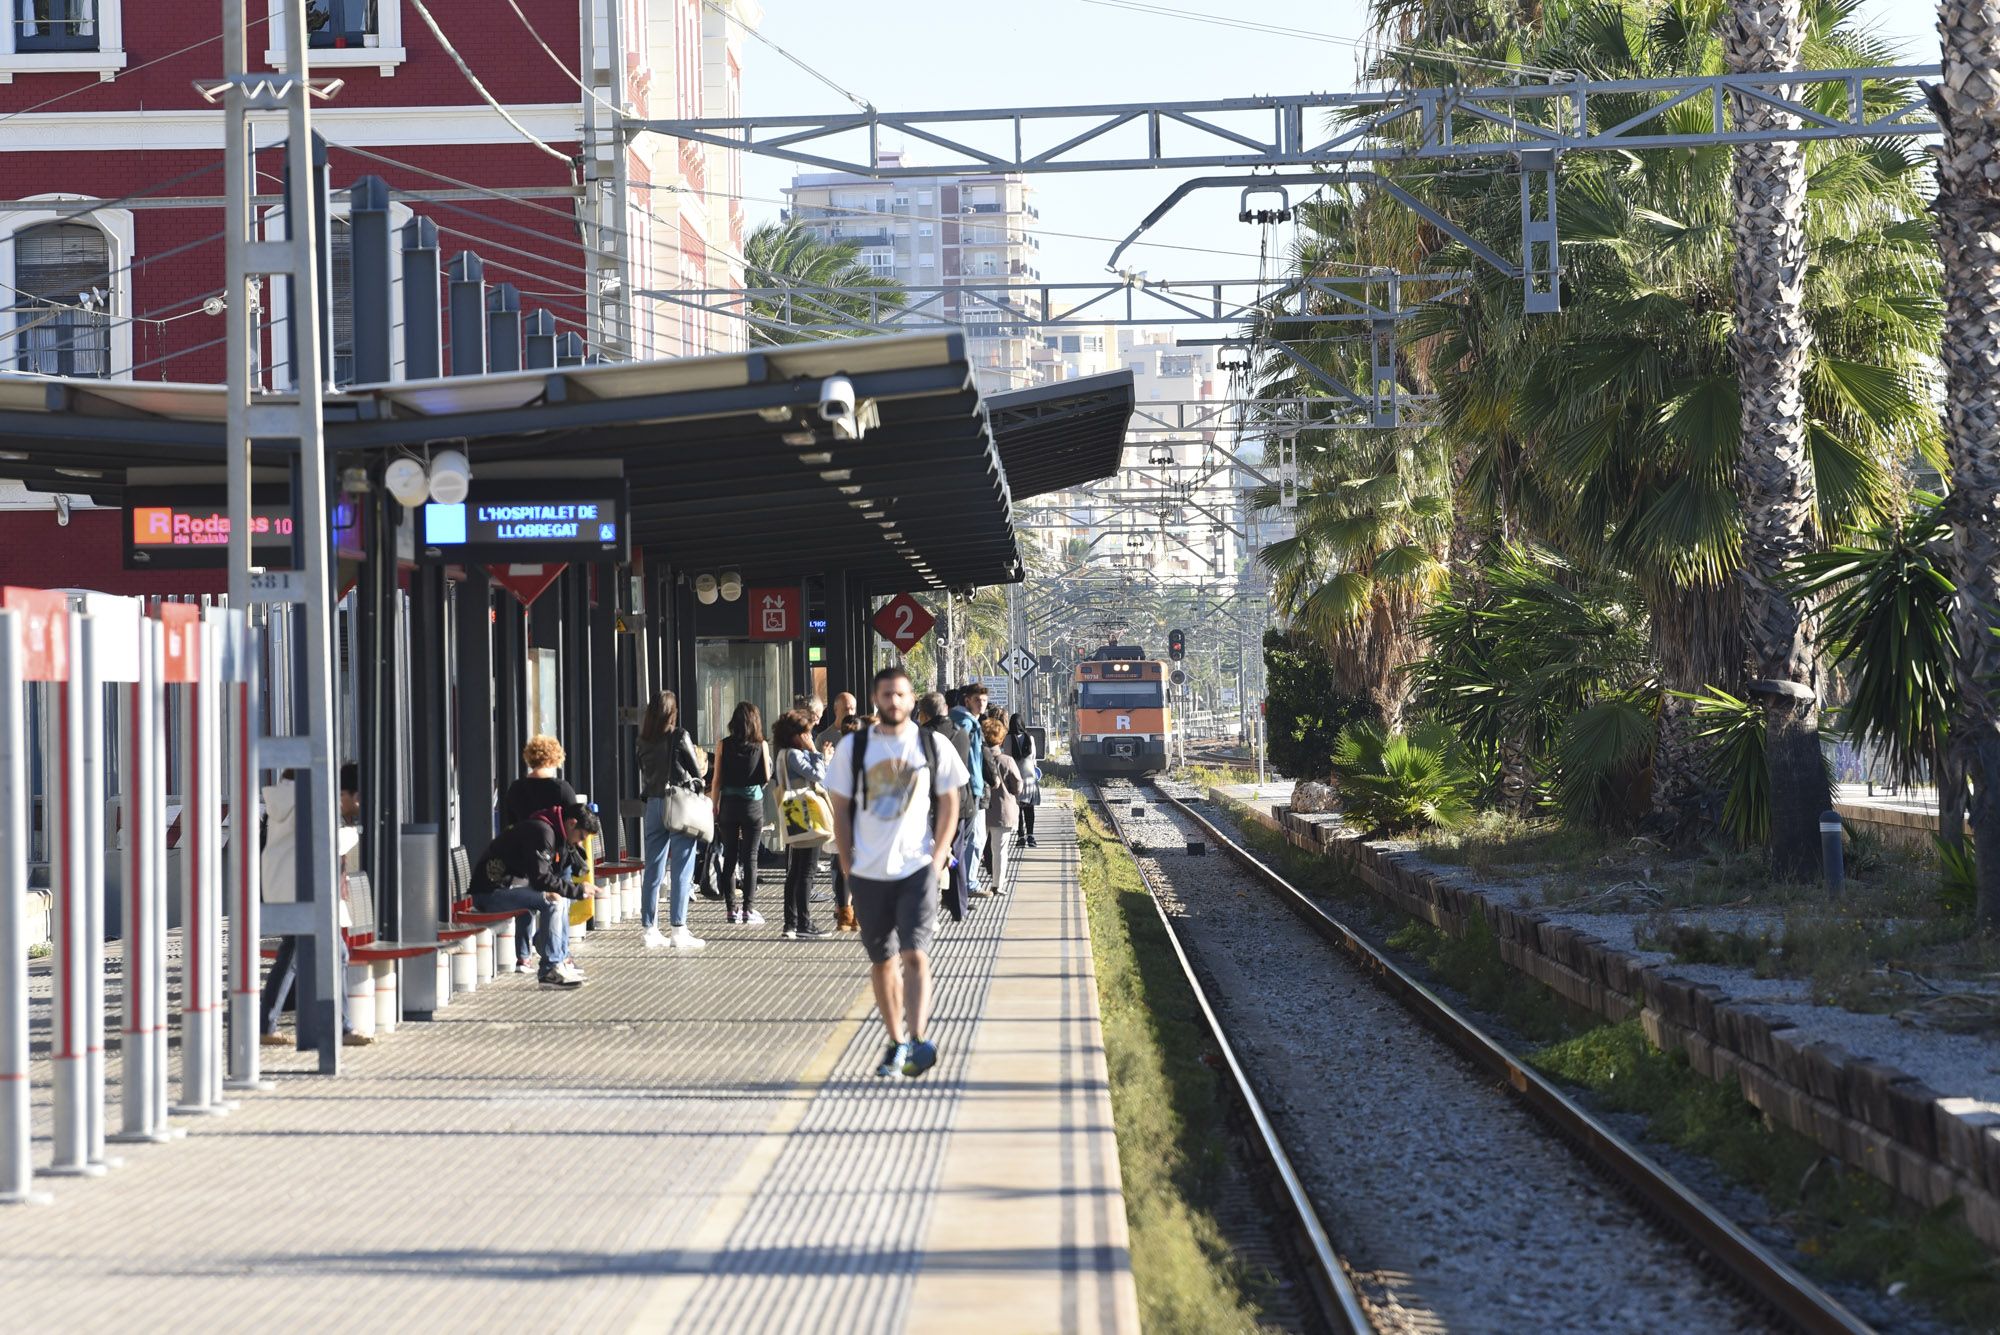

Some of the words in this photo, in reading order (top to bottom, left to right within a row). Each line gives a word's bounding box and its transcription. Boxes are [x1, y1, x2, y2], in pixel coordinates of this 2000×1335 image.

[479, 505, 575, 521] L'HOSPITALET
[578, 505, 598, 520] DE
[150, 512, 169, 534] R
[173, 513, 268, 534] Rodaes
[498, 523, 579, 538] LLOBREGAT
[895, 605, 914, 639] 2
[1116, 715, 1131, 730] R
